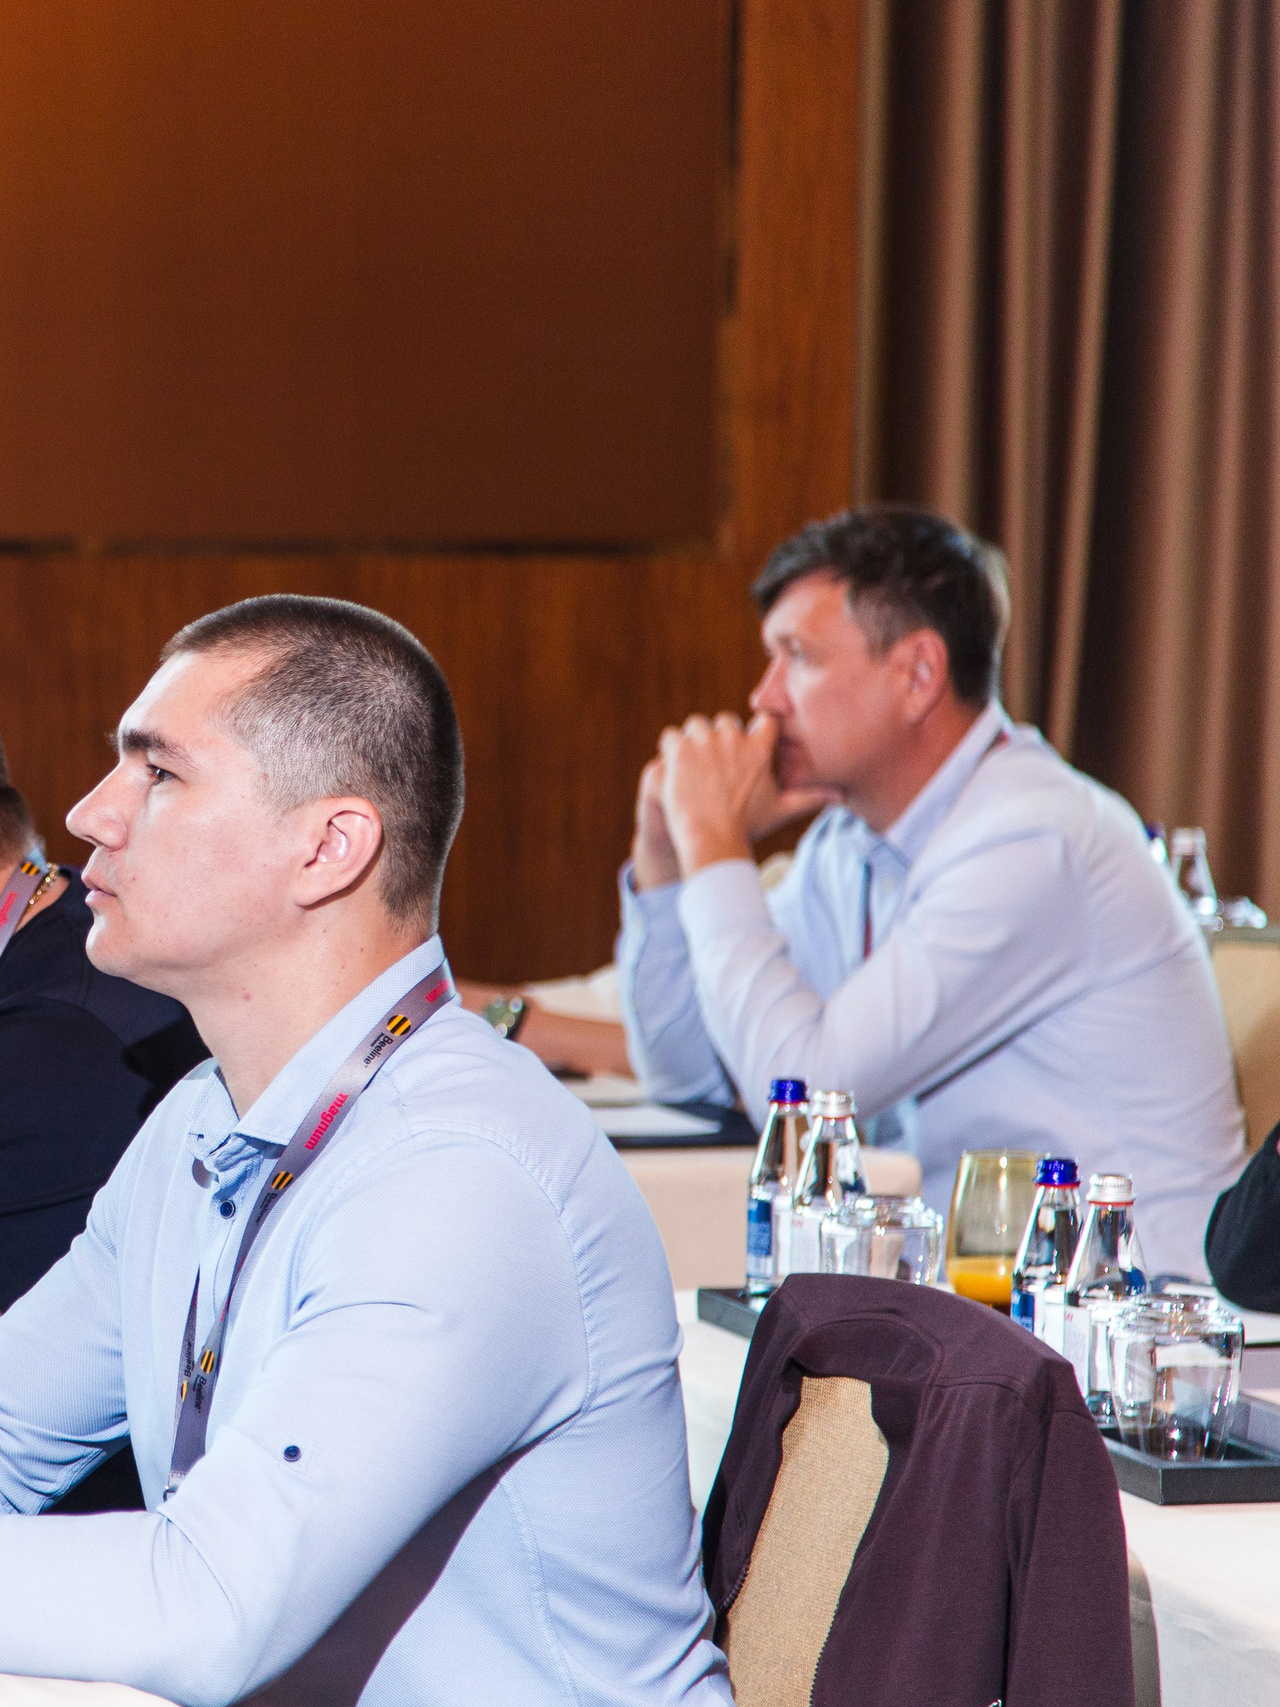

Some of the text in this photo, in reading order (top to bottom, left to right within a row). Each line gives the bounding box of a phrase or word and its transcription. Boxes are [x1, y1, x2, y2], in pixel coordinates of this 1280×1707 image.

[363, 1035, 394, 1065] Beeline
[304, 1093, 349, 1150] magnum
[194, 1376, 207, 1410] Beeline
